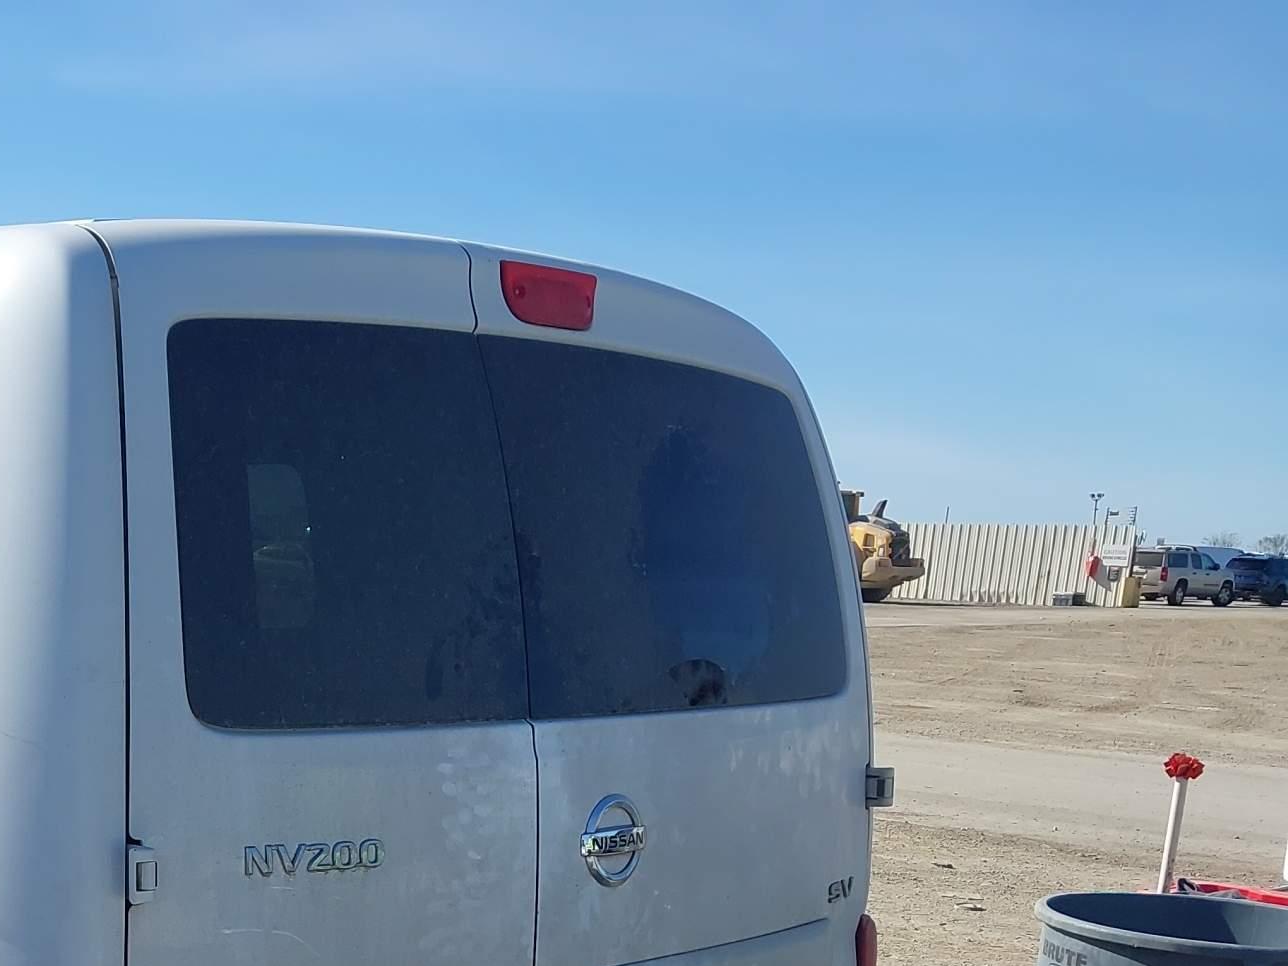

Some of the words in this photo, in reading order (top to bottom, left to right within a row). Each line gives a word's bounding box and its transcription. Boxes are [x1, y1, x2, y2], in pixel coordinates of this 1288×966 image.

[591, 829, 645, 852] NISSAN
[244, 838, 385, 878] NV200
[827, 876, 854, 904] SV
